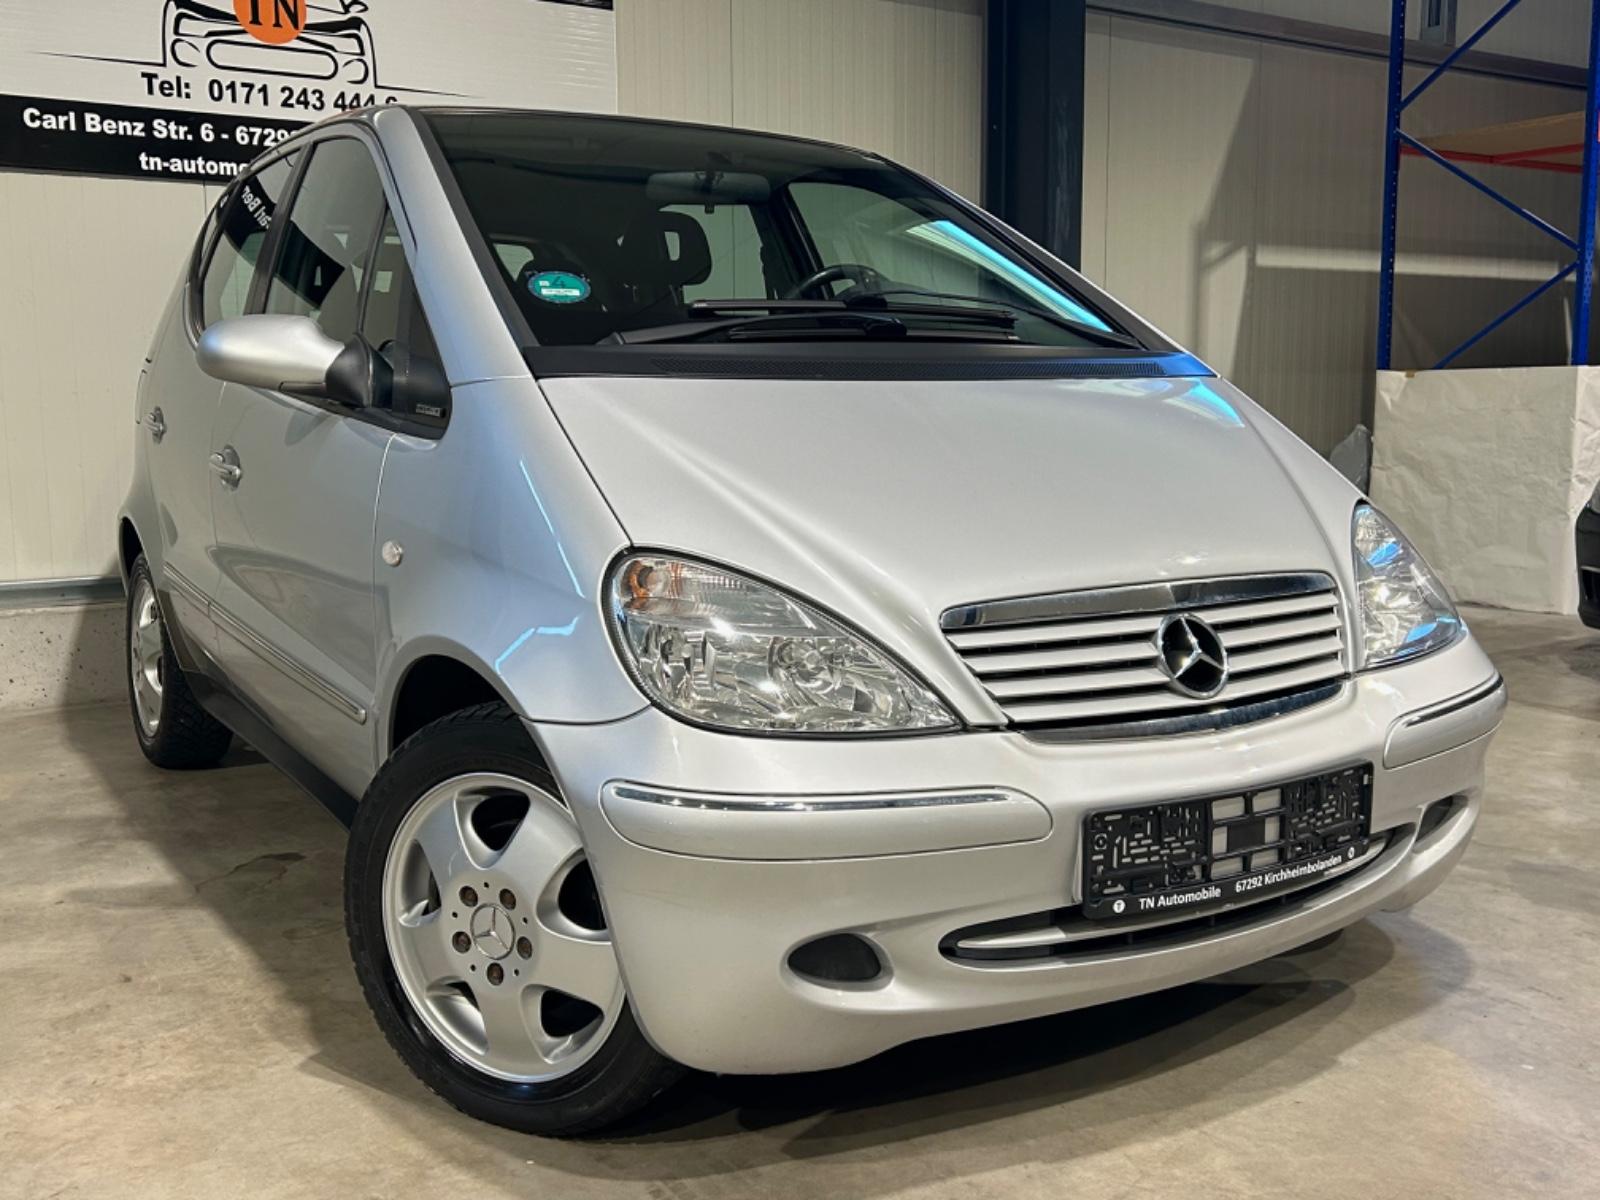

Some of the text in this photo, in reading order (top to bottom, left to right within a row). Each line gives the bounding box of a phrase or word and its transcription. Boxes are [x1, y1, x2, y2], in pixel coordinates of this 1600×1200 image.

[141, 72, 192, 99] Tel:
[208, 79, 269, 106] 0171
[280, 86, 325, 111] 243
[23, 107, 76, 131] Carl
[84, 112, 146, 137] Benz
[152, 118, 193, 141] Str.
[200, 123, 215, 142] 6
[1235, 855, 1342, 893] 67292 Kirchheimbolanden
[1139, 885, 1222, 910] TN Automobile
